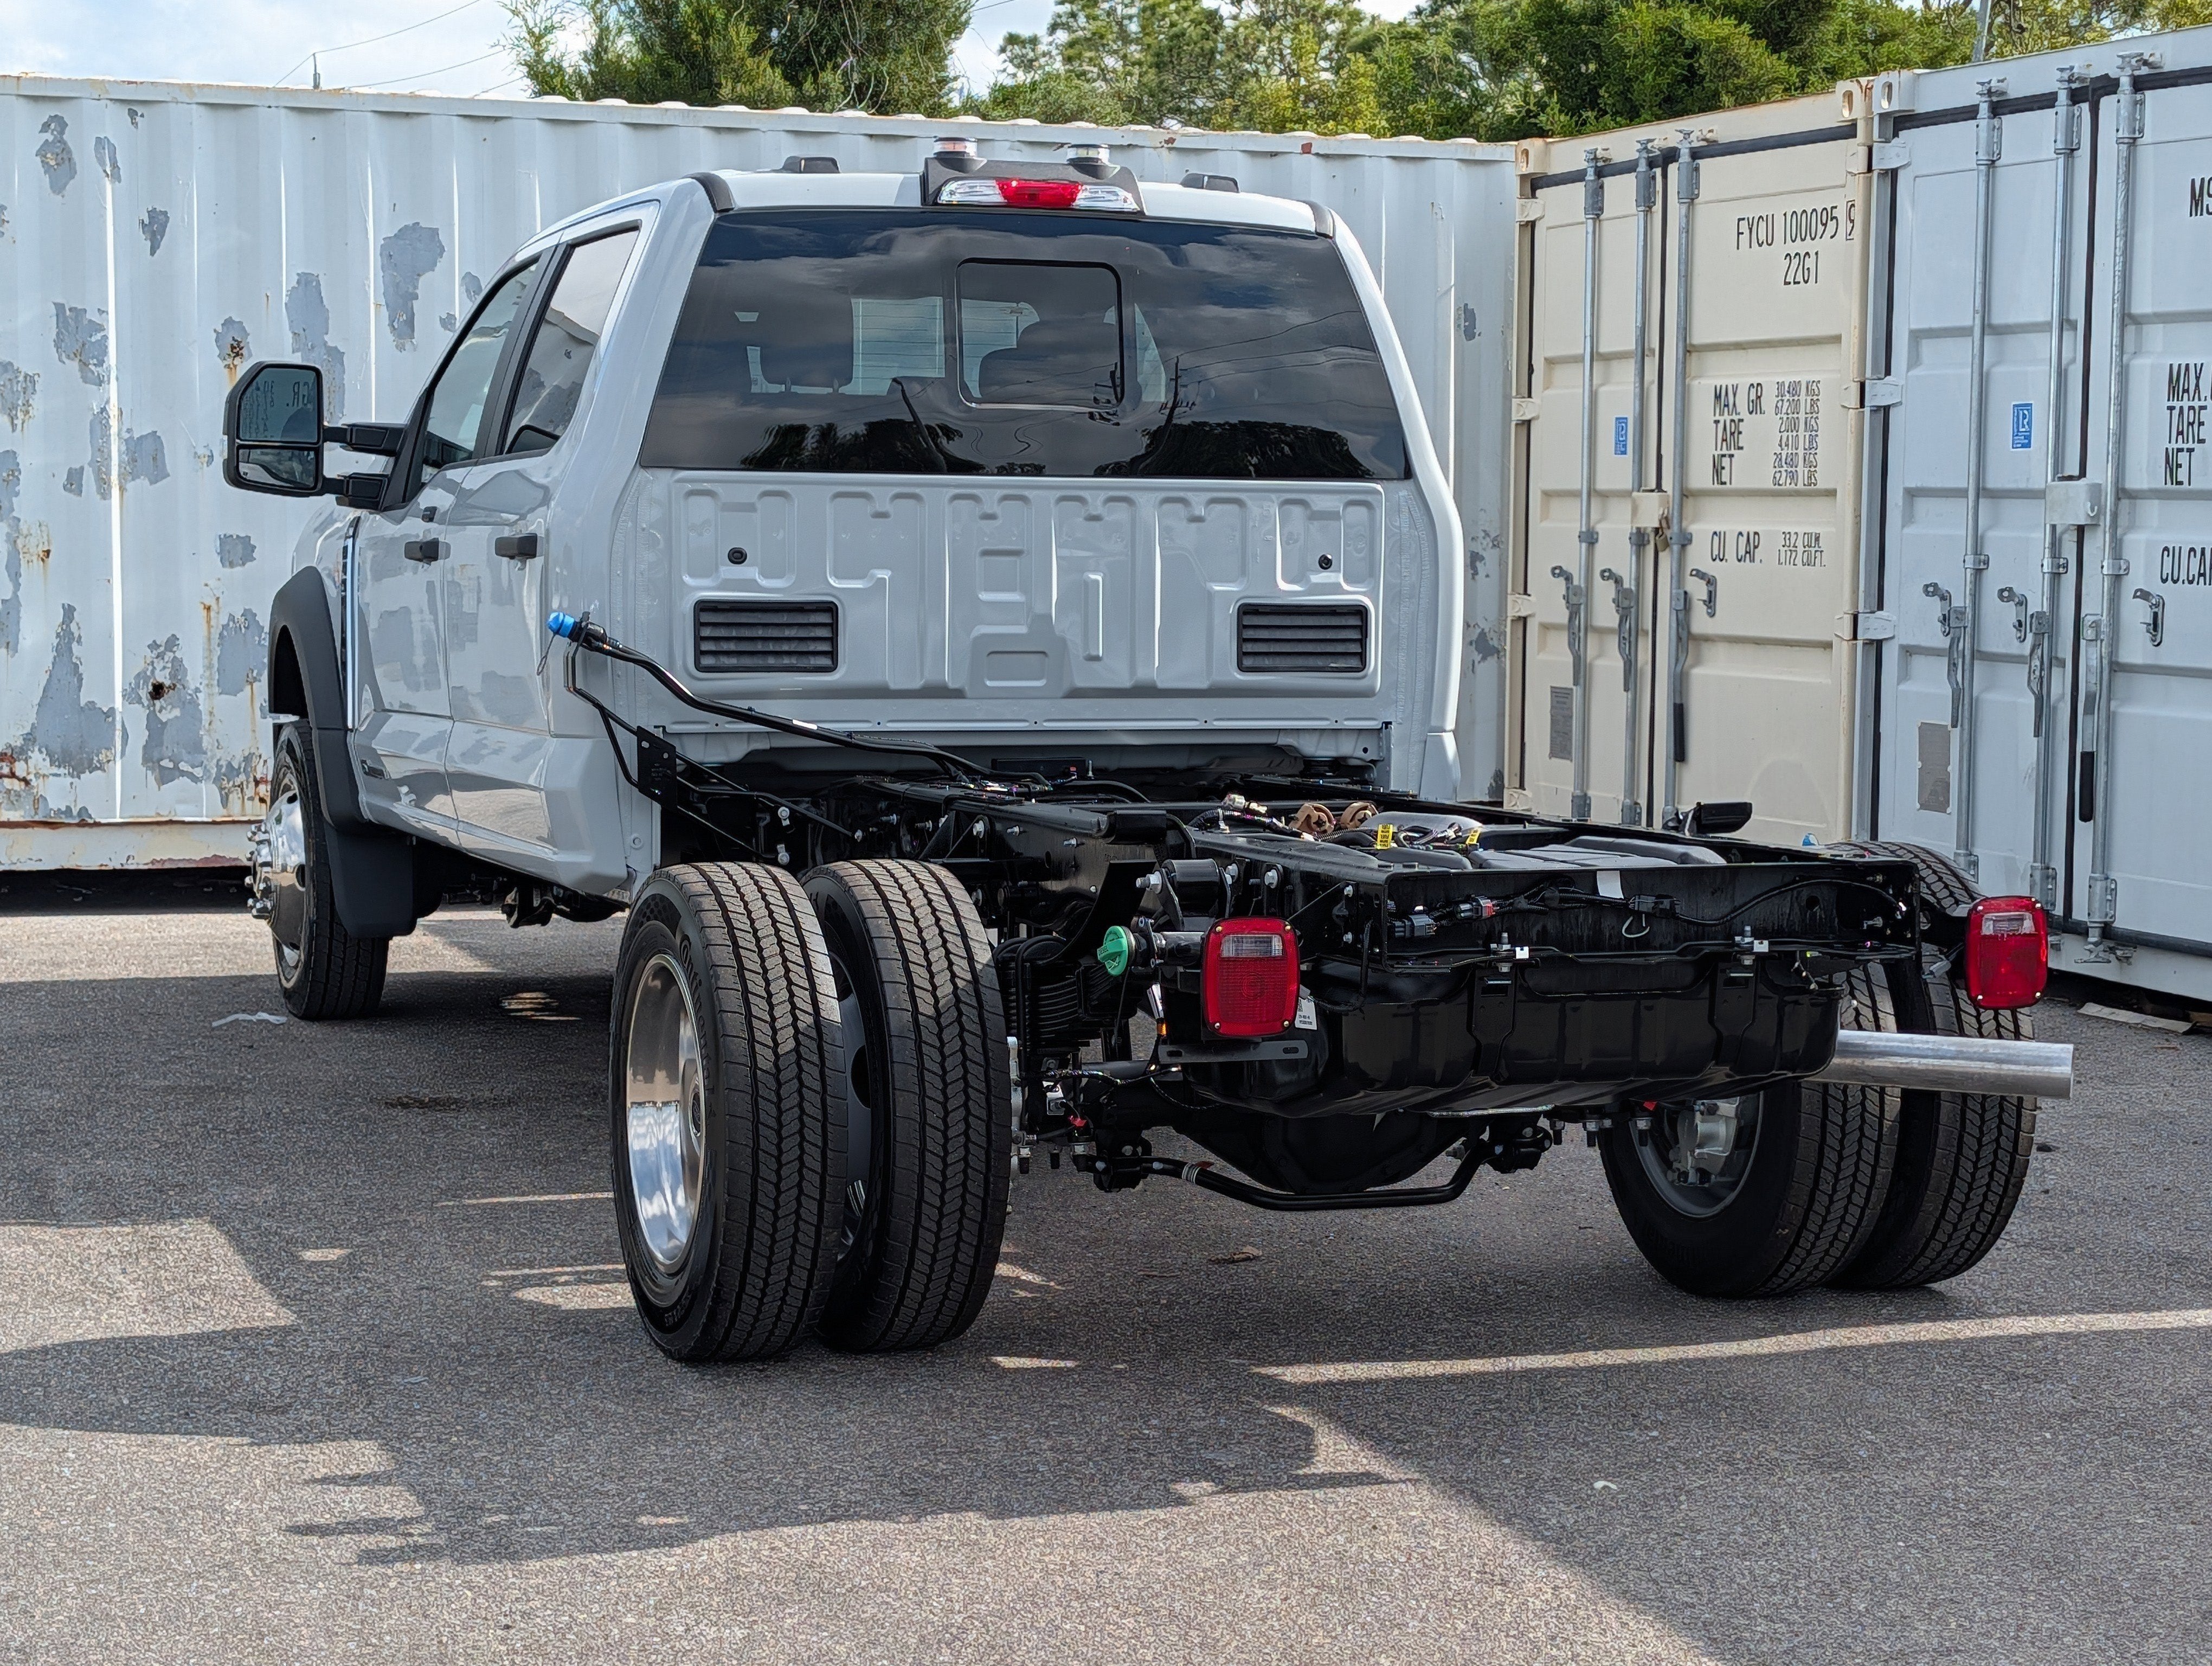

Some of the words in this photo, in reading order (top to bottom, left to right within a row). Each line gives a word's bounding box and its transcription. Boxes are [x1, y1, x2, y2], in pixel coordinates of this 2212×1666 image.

[1736, 213, 1775, 250] FYCU
[1783, 205, 1839, 245] 100095
[1783, 250, 1819, 285] 22G1
[1713, 383, 1740, 417] MAX.
[1747, 382, 1766, 415] GR.
[1805, 380, 1821, 397] KGS
[2167, 363, 2212, 402] MAX.
[1804, 398, 1820, 415] LBS
[1713, 419, 1744, 451] TARE
[1804, 416, 1819, 433] KGS
[2166, 405, 2208, 444] TARE
[1803, 434, 1818, 451] LBS
[1712, 453, 1735, 486] NET
[1803, 470, 1818, 486] LBS
[2164, 447, 2195, 486] NET
[1711, 531, 1728, 563] CU.
[1736, 531, 1763, 563] CAP.
